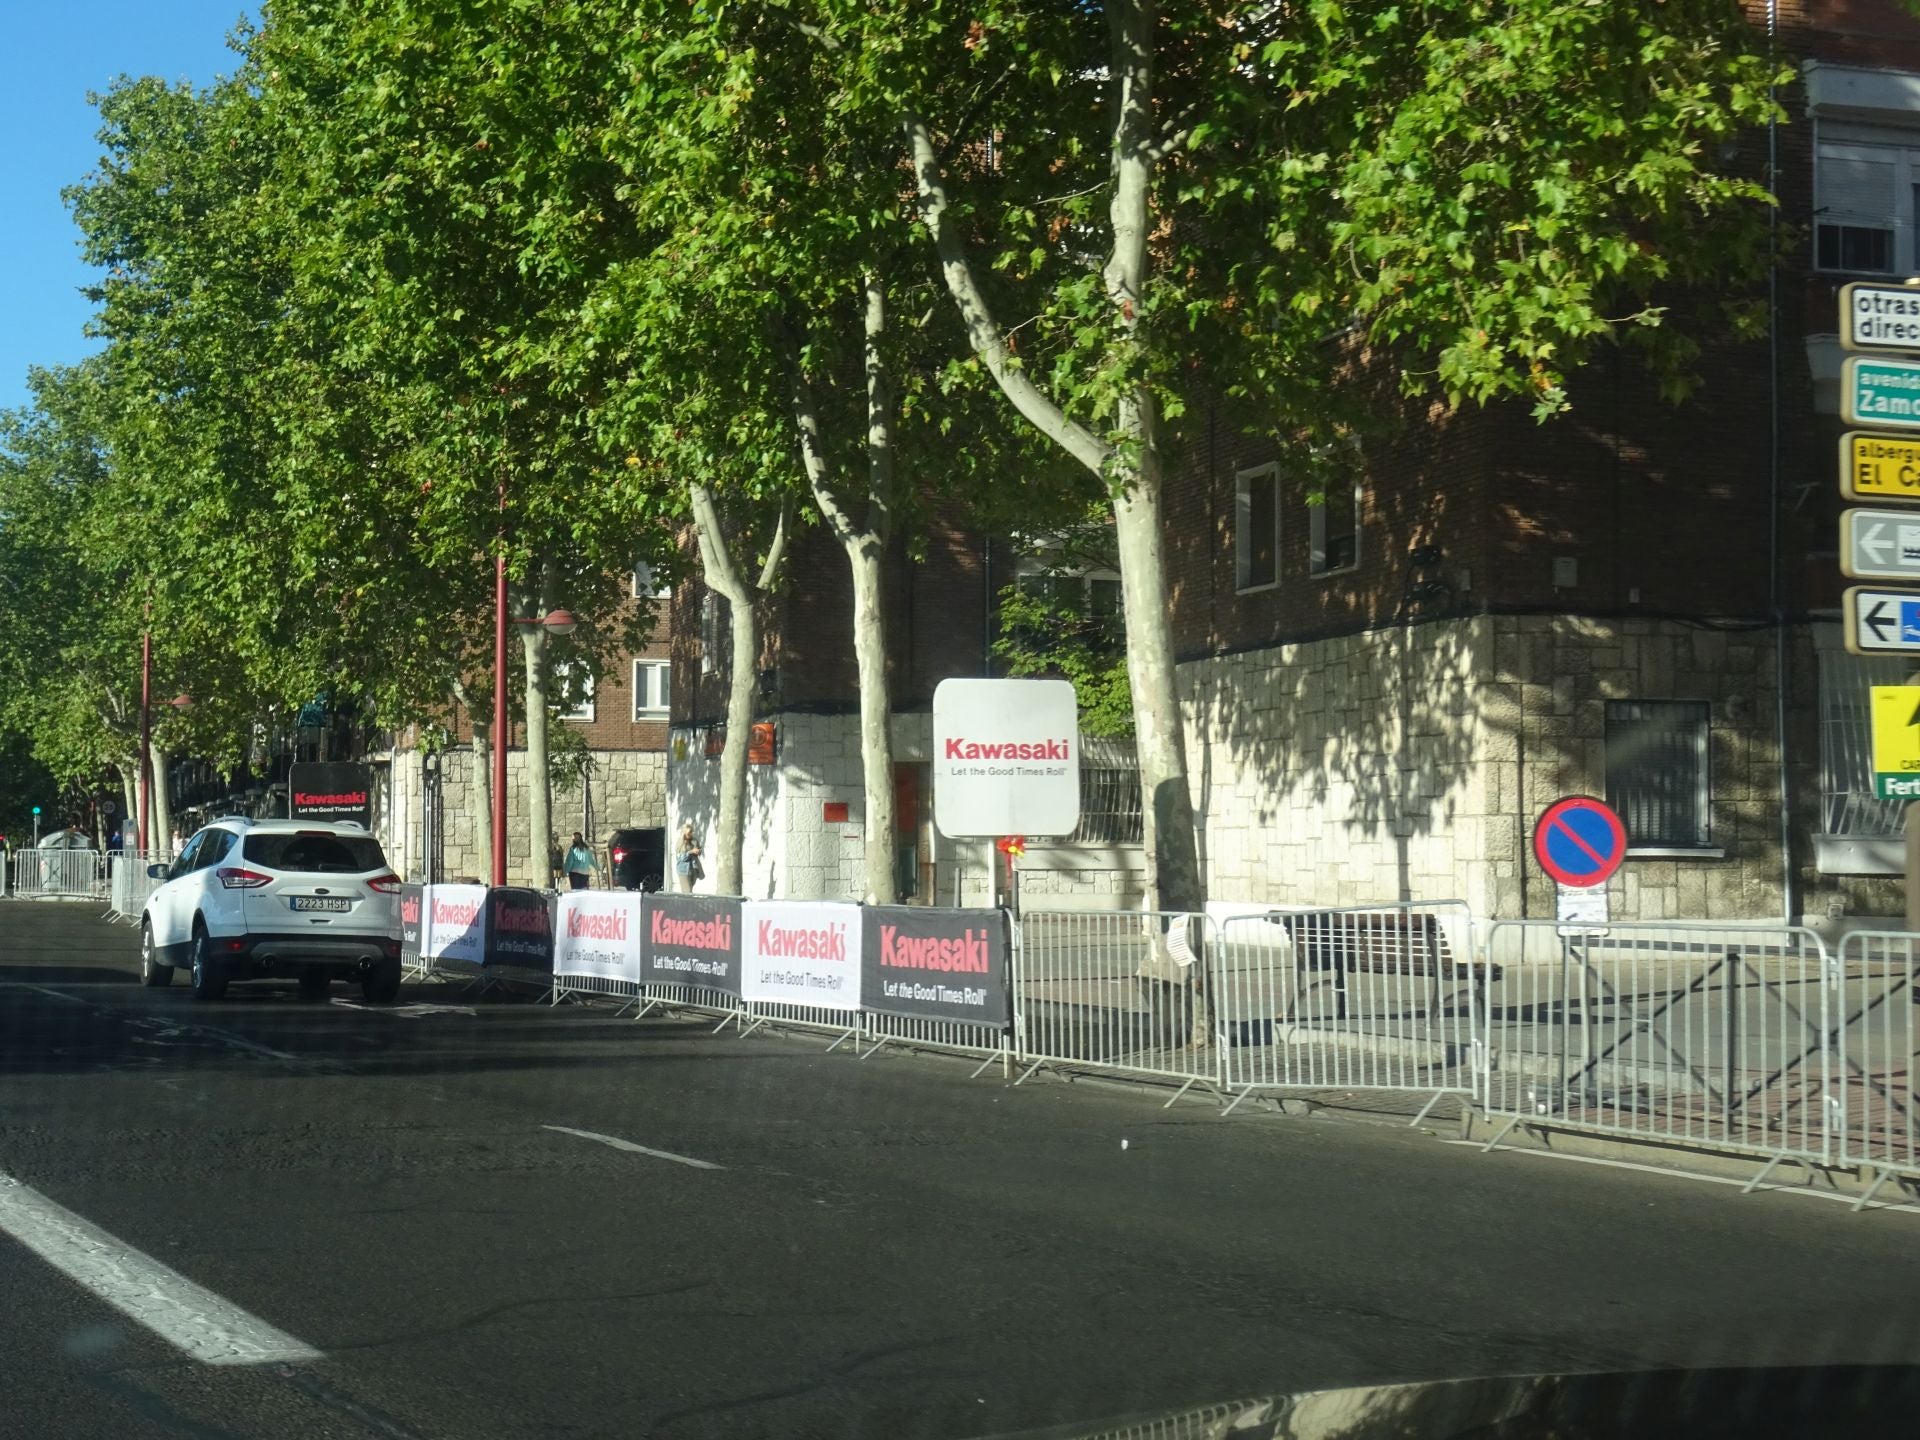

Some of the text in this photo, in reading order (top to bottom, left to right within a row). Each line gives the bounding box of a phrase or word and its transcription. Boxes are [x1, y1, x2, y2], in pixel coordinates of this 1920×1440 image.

[1860, 293, 1920, 315] otras
[1860, 317, 1920, 339] direc
[1860, 464, 1920, 488] El C
[946, 738, 1068, 760] Kawasaki
[952, 768, 966, 776] Let
[970, 768, 985, 776] the
[988, 767, 1014, 776] Good
[1016, 768, 1044, 776] Times
[295, 792, 366, 805] Kawasaki
[298, 899, 346, 909] 2223 HSP
[432, 898, 480, 928] Kawasaki
[495, 902, 549, 936] Kawasaki
[567, 908, 627, 940] Kawasaki
[652, 910, 731, 950] Kawasaki
[758, 920, 846, 961] Kawasaki
[880, 925, 988, 973] Kawasaki
[582, 949, 594, 962] Good
[595, 950, 611, 964] Times
[654, 955, 663, 969] Let
[664, 956, 674, 969] the
[674, 956, 691, 971] Good
[692, 959, 712, 974] Times
[761, 970, 772, 984] Let
[774, 970, 784, 984] the
[786, 970, 804, 986] Good
[806, 972, 826, 988] Times
[884, 980, 898, 997] Let
[899, 982, 912, 998] the
[914, 983, 936, 1001] Good
[937, 985, 963, 1004] Times
